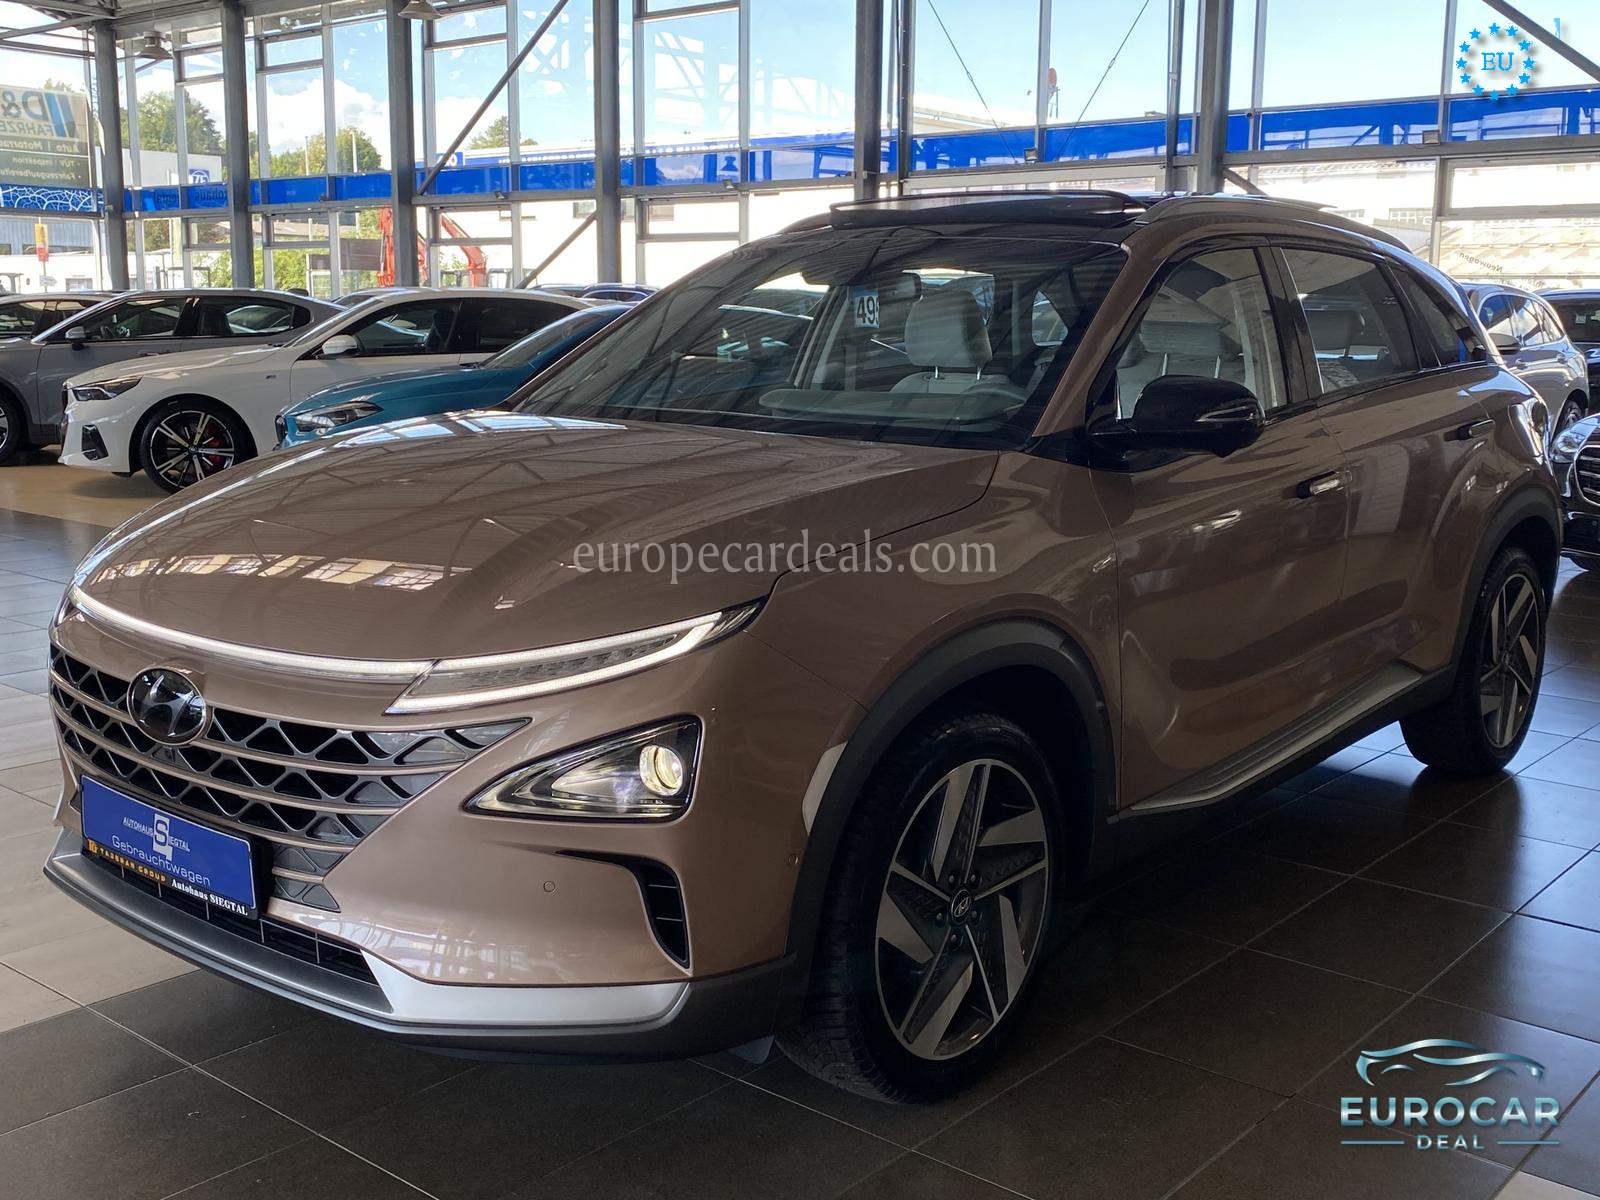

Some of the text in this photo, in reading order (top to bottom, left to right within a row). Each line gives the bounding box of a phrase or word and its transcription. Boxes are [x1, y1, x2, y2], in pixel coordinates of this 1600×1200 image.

[123, 816, 154, 837] AUTOHAUS
[112, 835, 211, 887] Gebrauchtwagen
[171, 879, 248, 916] Autohaus SIEGTAL
